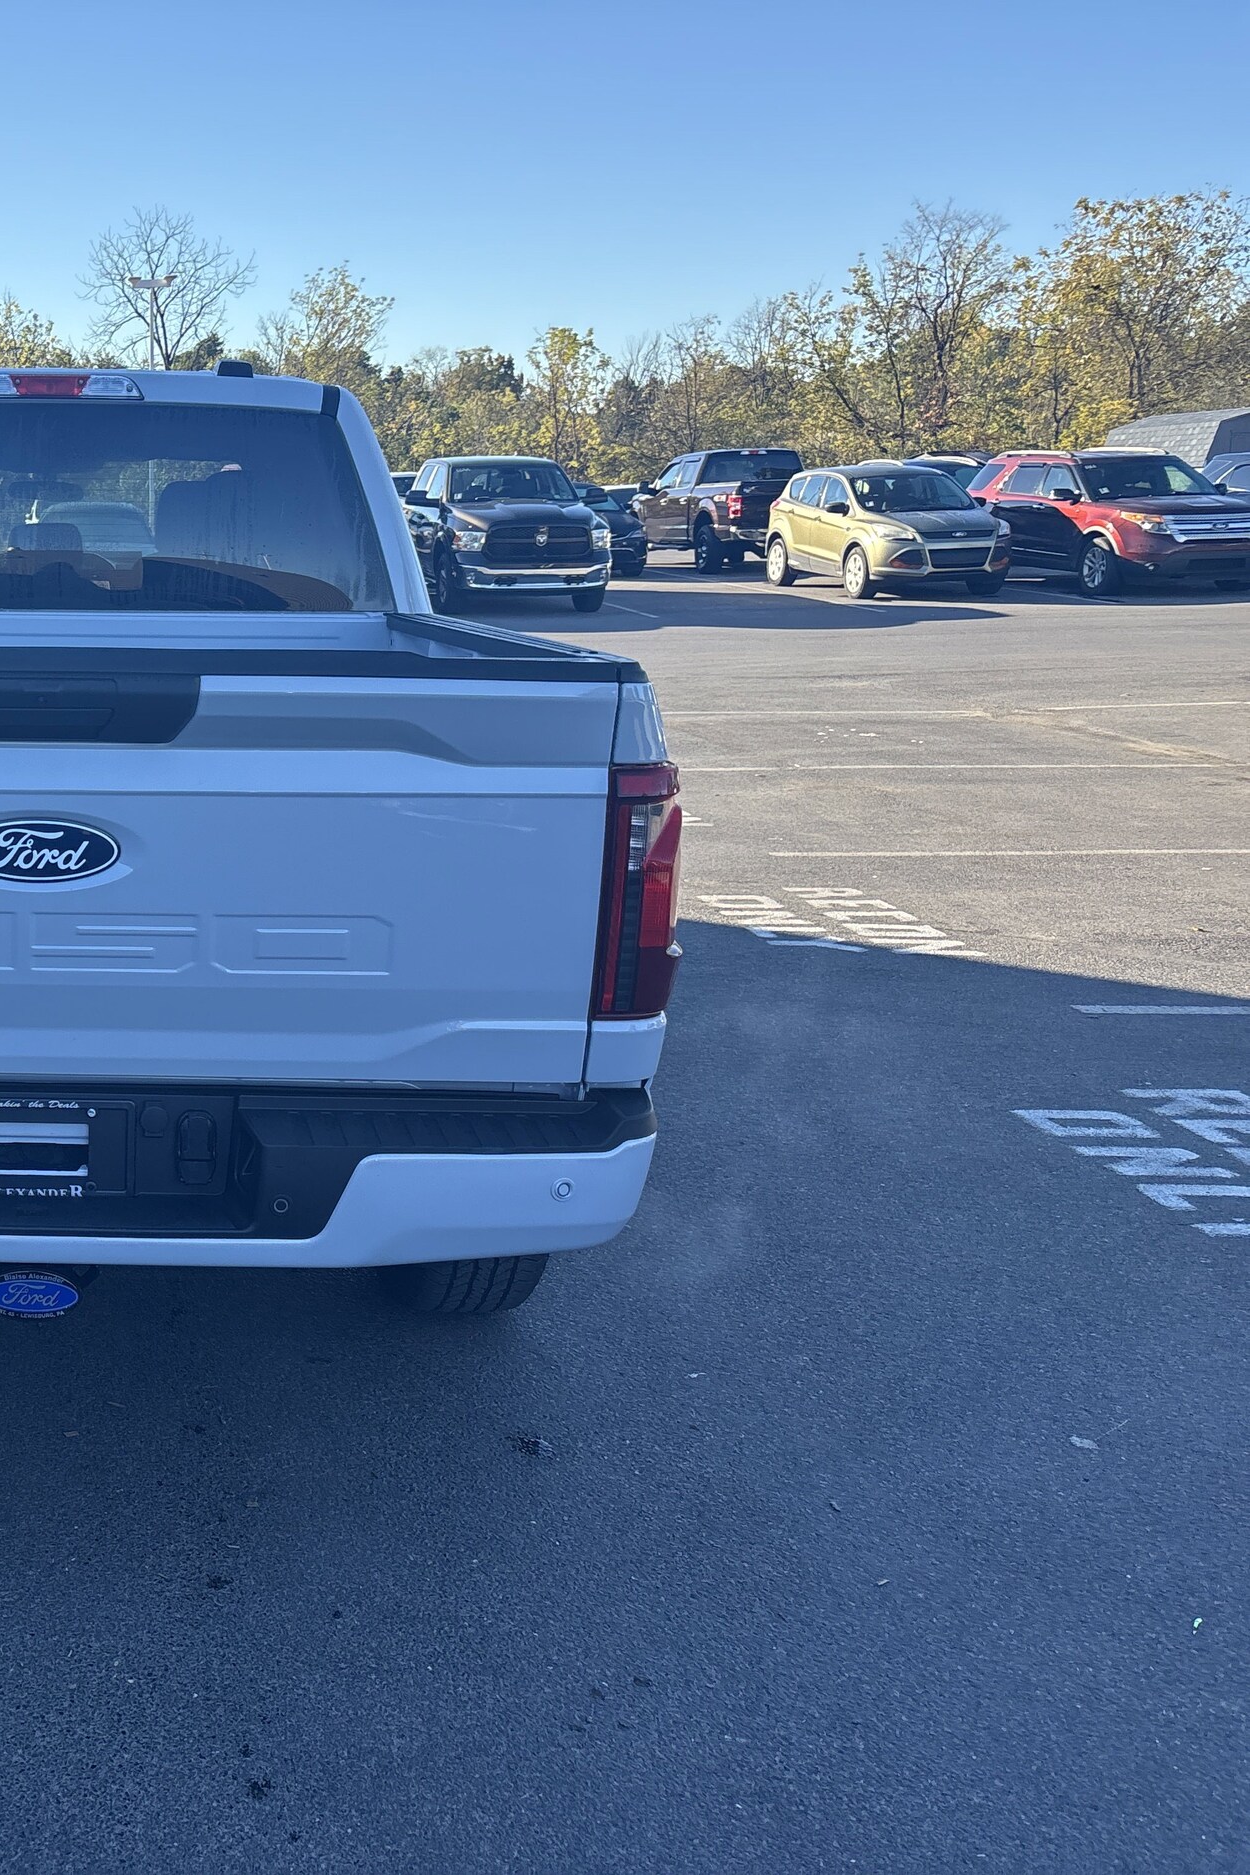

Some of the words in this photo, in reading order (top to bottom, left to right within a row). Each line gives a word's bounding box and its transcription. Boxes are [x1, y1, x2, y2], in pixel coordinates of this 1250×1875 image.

[28, 1100, 44, 1108] the
[48, 1100, 80, 1109] Deals
[3, 1273, 27, 1281] Blaise
[28, 1273, 64, 1284] Alexander
[1, 1282, 61, 1307] Ford
